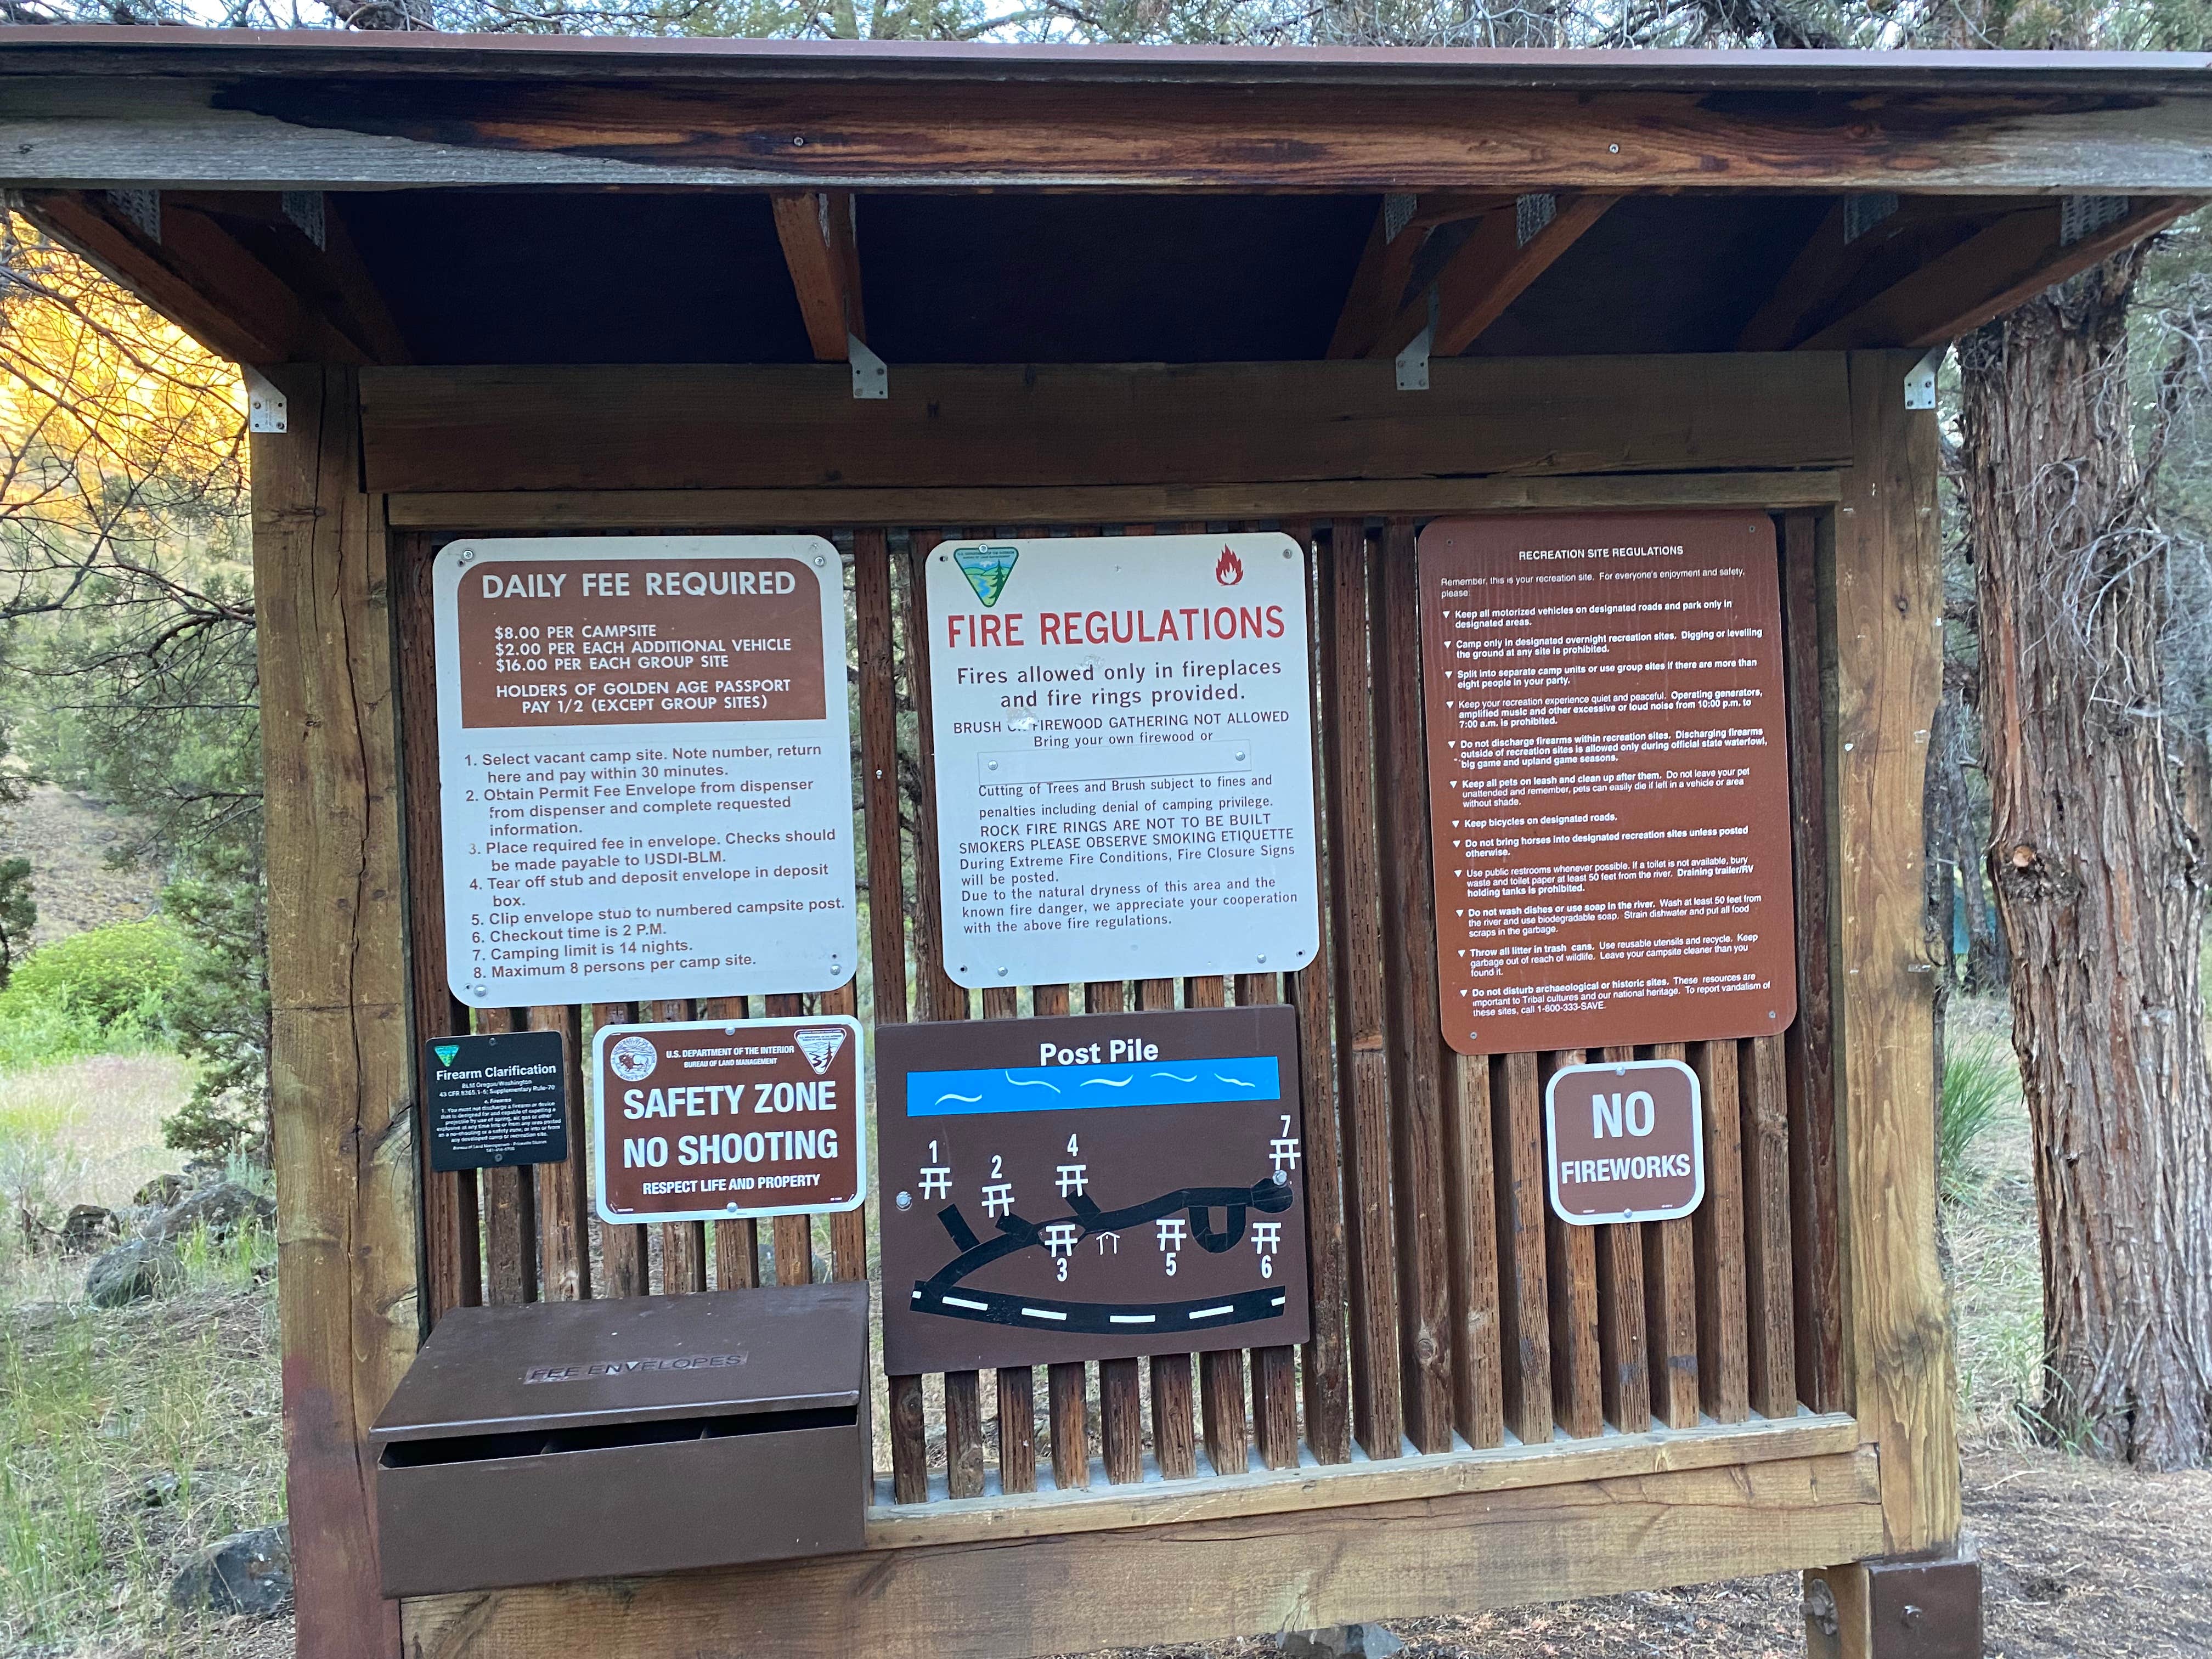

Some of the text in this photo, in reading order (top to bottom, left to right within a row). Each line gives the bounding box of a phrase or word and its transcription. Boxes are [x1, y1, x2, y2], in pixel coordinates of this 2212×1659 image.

[1519, 545, 1684, 561] RECREATION SITE REGULATIONS
[483, 572, 795, 598] DAILY FEE REQUIRED
[1490, 576, 1505, 584] this
[1515, 576, 1534, 586] your
[1536, 573, 1576, 583] recreation
[1599, 572, 1613, 581] For
[1615, 570, 1658, 582] everyone's
[1660, 569, 1700, 580] enjoyment
[1702, 568, 1718, 577] and
[1455, 610, 1477, 621] Keep
[1479, 608, 1490, 618] all
[1492, 607, 1536, 617] motorized
[1537, 606, 1574, 615] vehicles
[1589, 603, 1637, 615] designated
[1638, 602, 1663, 612] roads
[1664, 601, 1681, 611] and
[1683, 600, 1702, 612] park
[1703, 600, 1722, 611] only
[1724, 599, 1732, 608] in
[495, 625, 656, 641] $8.00 PER CAMPSITE
[948, 606, 1284, 647] FIRE REGULATIONS
[495, 639, 791, 657] $2.00 PER EACH ADDITIONAL VEHICLE
[496, 655, 728, 673] $16.00 PER EACH GROUP SITE
[958, 659, 1281, 684] Fires allowed only in fireplaces
[496, 679, 791, 697] HOLDERS OF GOLDEN AGE PASSPORT
[1001, 684, 1244, 708] and fire rings provided.
[523, 695, 767, 713] PAY 1/2 (EXCEPT GROUP SITES)
[954, 721, 1001, 733] BRUSH
[1033, 718, 1102, 731] FIREWOOD
[1109, 715, 1188, 728] GATHERING
[1194, 713, 1221, 725] NOT
[1227, 711, 1289, 724] ALLOWED
[465, 745, 821, 766] 1. Select vacant camp site. Note number, return
[981, 814, 1271, 837] ROCK FIRE RINGS ARE NOT TO BE BUILT
[1464, 819, 1487, 829] Keep
[1488, 817, 1525, 828] bicycles
[1540, 814, 1588, 825] designated
[472, 923, 666, 943] 6. Checkout time is 2 P.M.
[473, 940, 692, 961] 7. Camping limit is 14 nights.
[474, 954, 755, 978] 8. Maximum 8 persons per camp site.
[1473, 1008, 1496, 1017] these
[1521, 1005, 1535, 1014] call
[667, 1050, 681, 1058] U.S.
[682, 1048, 732, 1057] DEPARTMENT
[760, 1046, 794, 1054] INTERIOR
[1041, 1039, 1158, 1066] Post Pile
[436, 1063, 556, 1081] Firearm Clarification
[624, 1081, 836, 1119] SAFETY ZONE
[1593, 1091, 1655, 1138] NO
[1280, 1115, 1291, 1137] 7
[624, 1129, 838, 1168] NO SHOOTING
[929, 1141, 938, 1163] 1
[1067, 1134, 1079, 1156] 4
[991, 1155, 1002, 1178] 2
[1562, 1154, 1690, 1183] FIREWORKS
[643, 1174, 820, 1194] RESPECT LIFE AND PROPERTY
[1057, 1259, 1068, 1282] 3
[1166, 1253, 1177, 1276] 5
[1261, 1255, 1272, 1278] 6
[531, 1355, 741, 1380] FEE ENVELOPES
